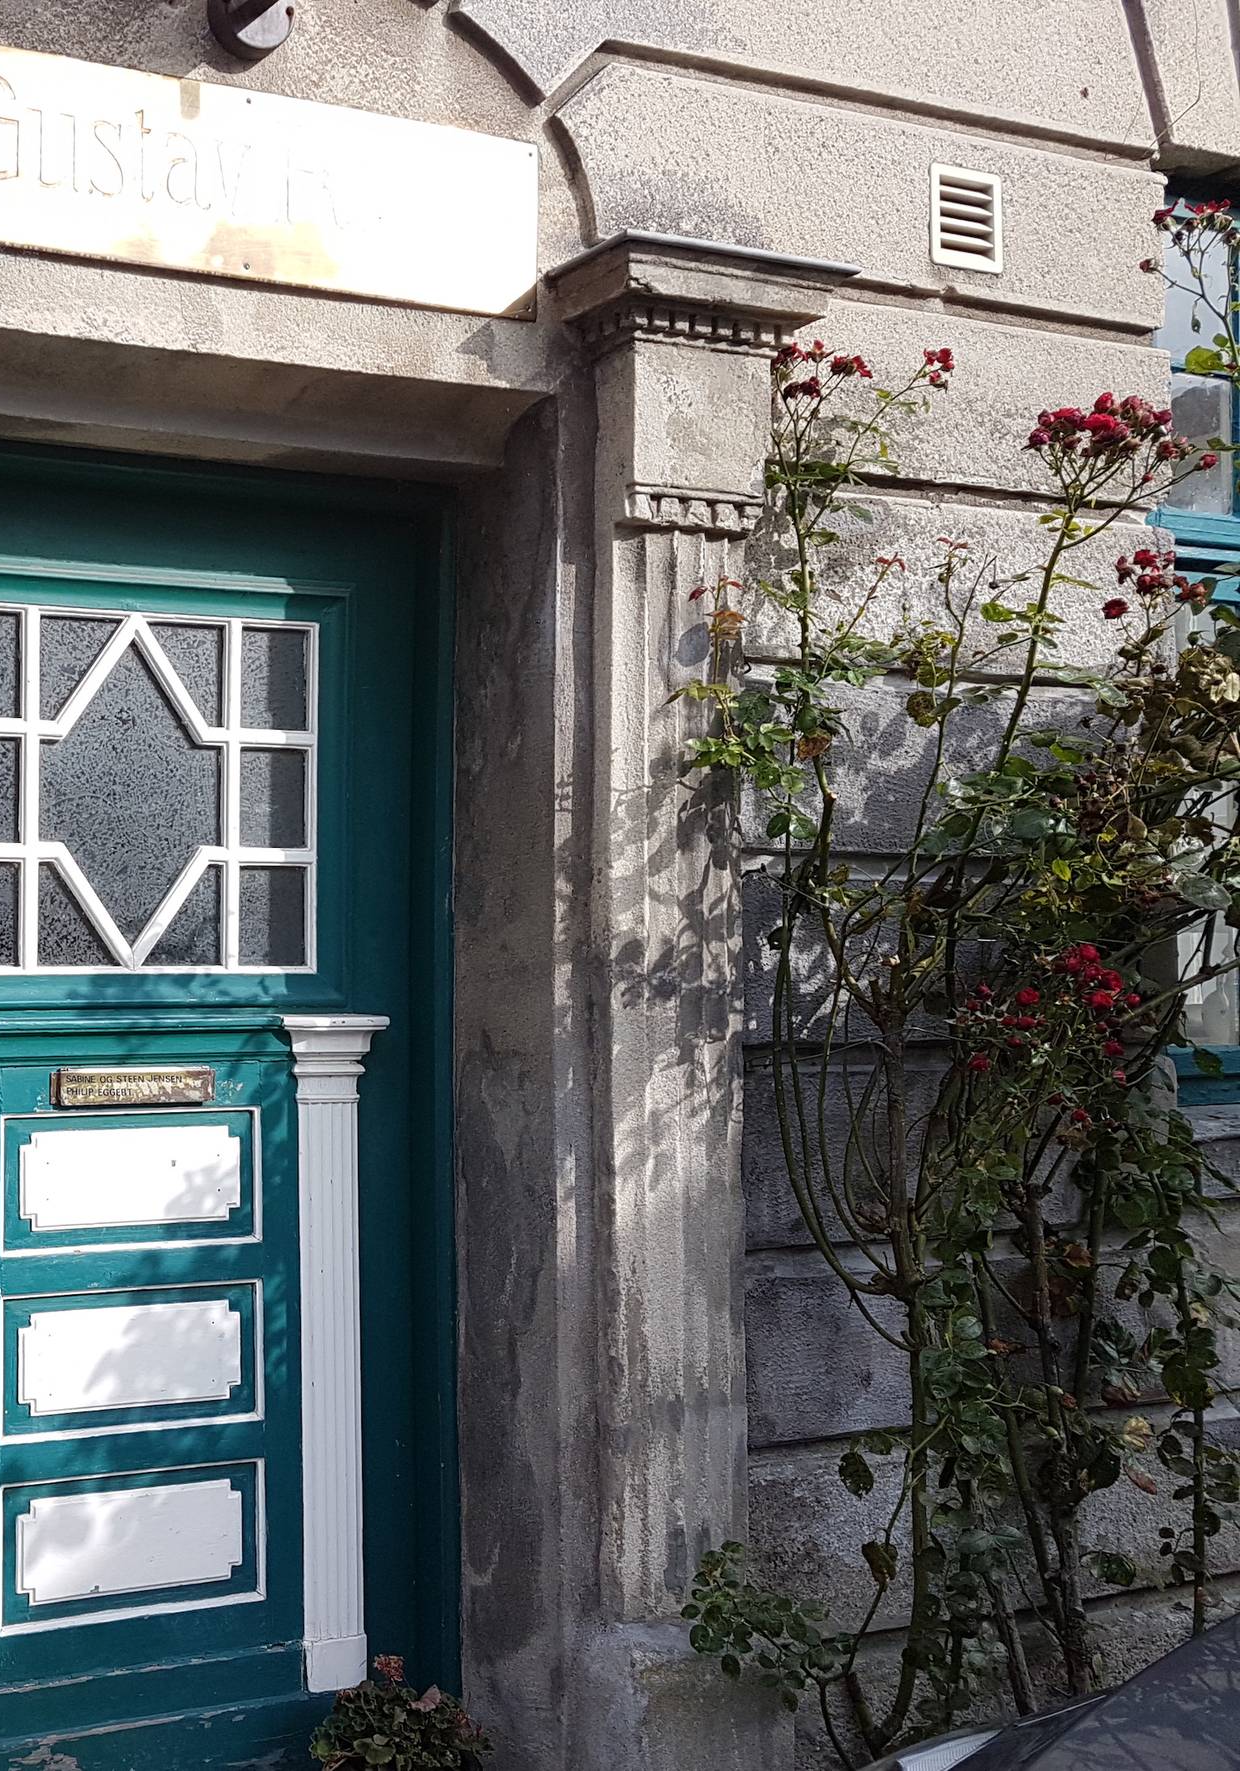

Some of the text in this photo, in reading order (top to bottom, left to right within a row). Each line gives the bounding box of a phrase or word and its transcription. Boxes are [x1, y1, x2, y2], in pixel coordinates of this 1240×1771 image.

[65, 1074, 182, 1083] SABINE OG STEEN JENSEN
[66, 1088, 94, 1097] PHILIP
